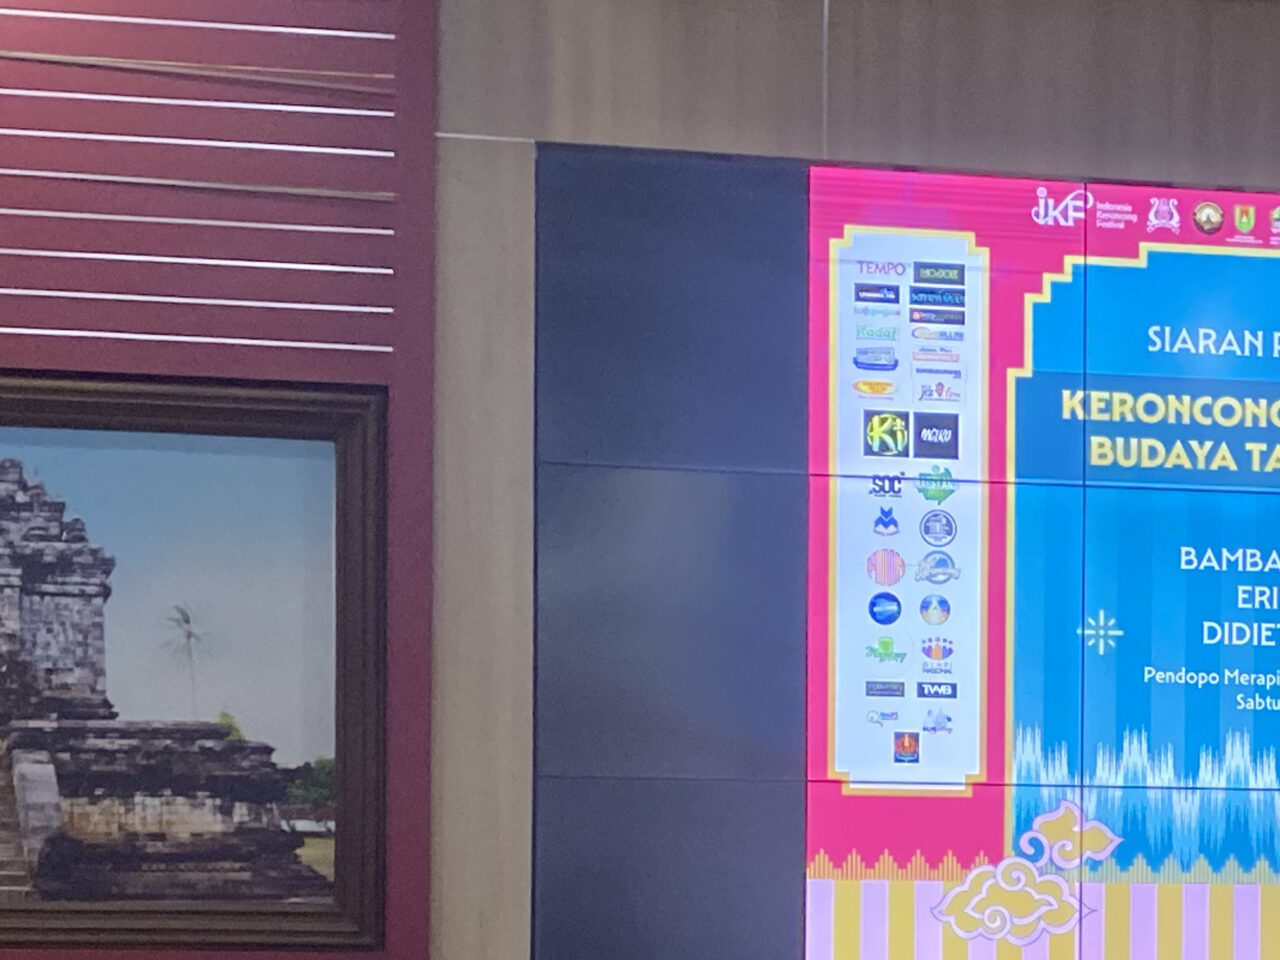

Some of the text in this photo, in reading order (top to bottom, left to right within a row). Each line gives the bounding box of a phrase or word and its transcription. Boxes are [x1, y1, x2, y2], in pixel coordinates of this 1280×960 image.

[856, 259, 906, 276] TEMPO
[1147, 325, 1263, 358] SIARAN
[1089, 435, 1239, 471] BUDAYA
[1143, 666, 1220, 690] Pendopo
